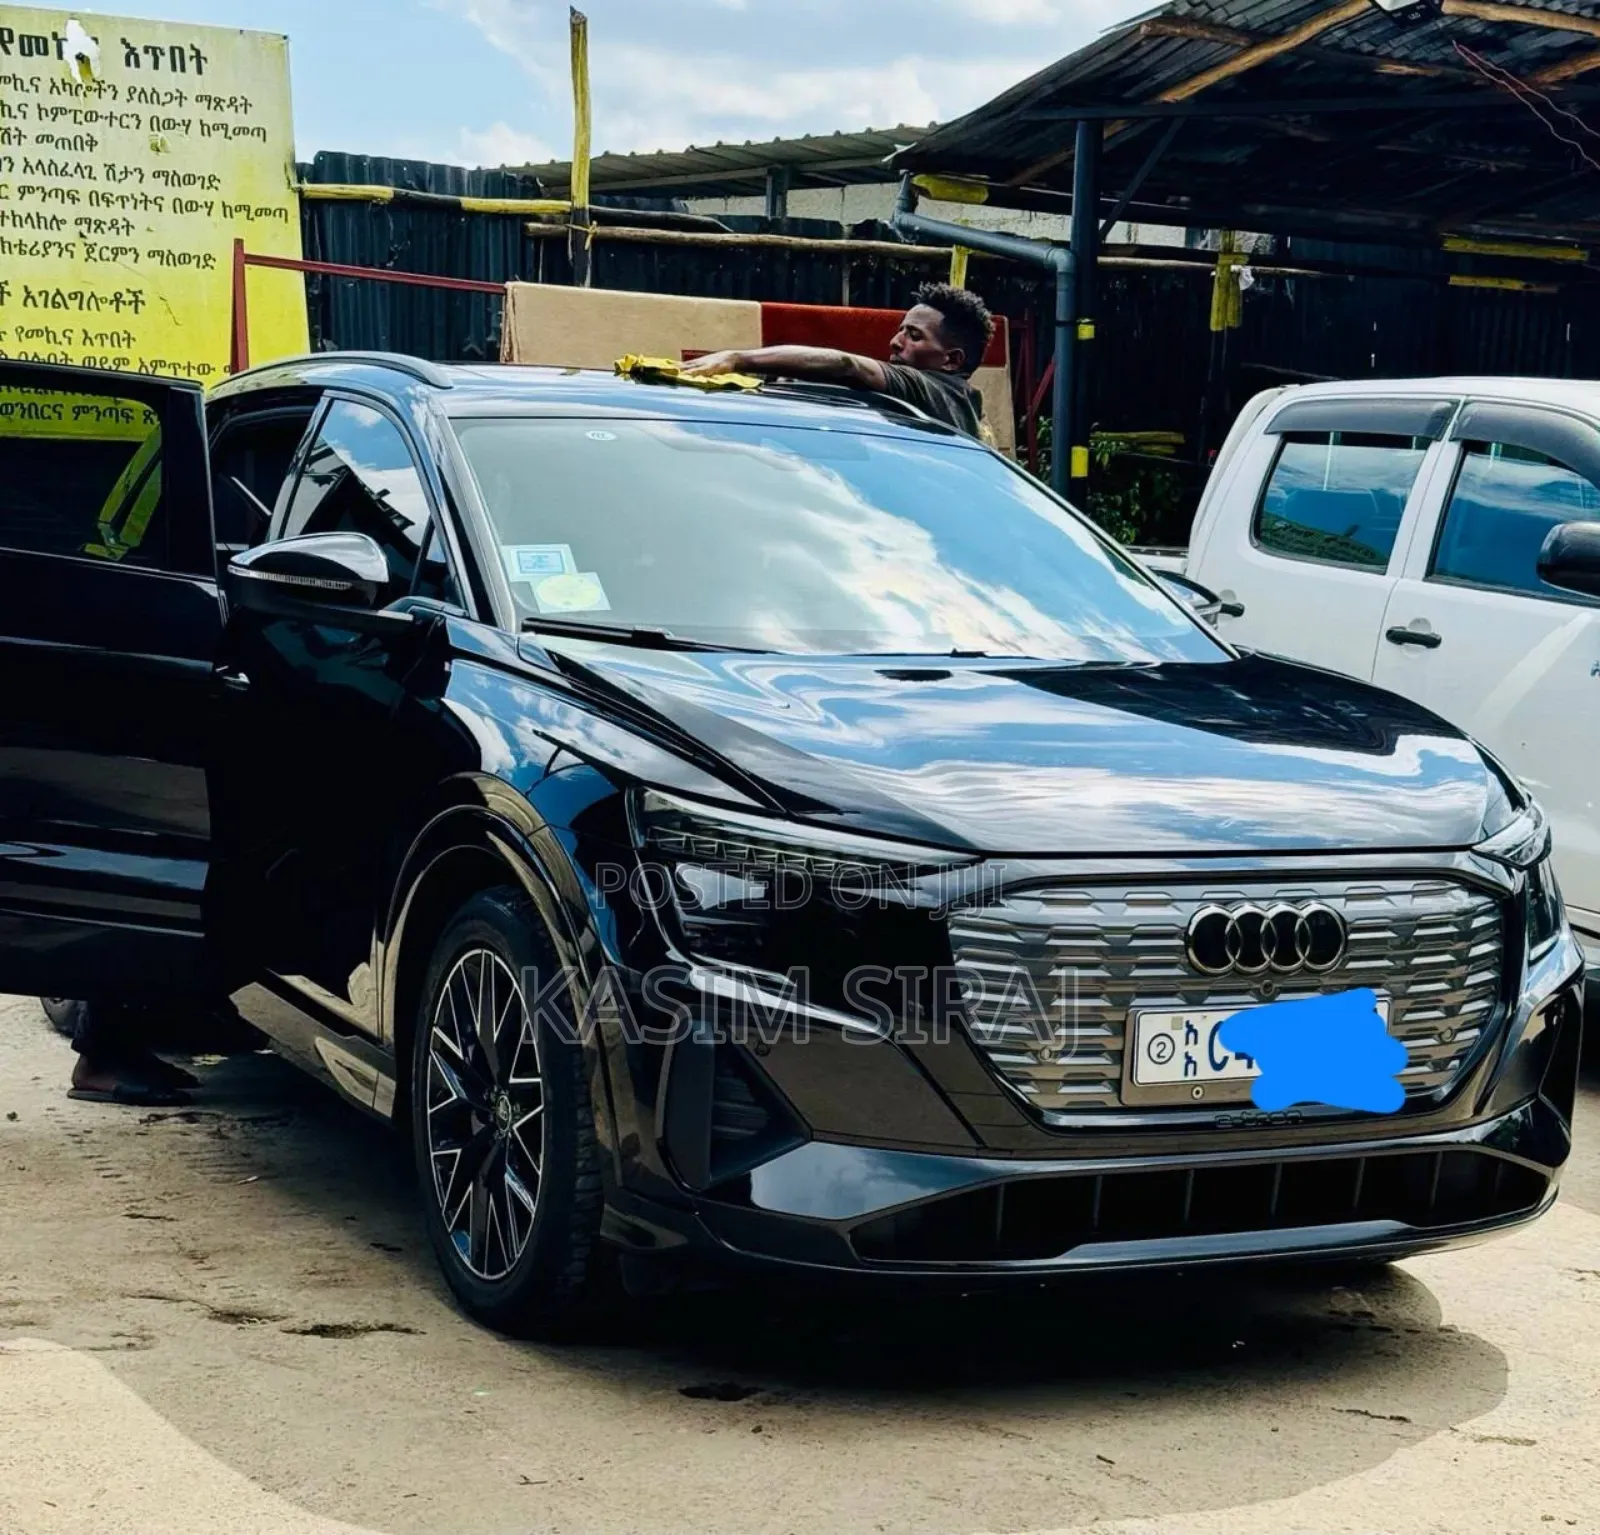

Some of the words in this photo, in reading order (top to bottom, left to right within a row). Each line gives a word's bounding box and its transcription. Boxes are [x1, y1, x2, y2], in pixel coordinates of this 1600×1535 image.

[120, 36, 208, 76] እጥበት
[125, 84, 189, 109] ያለስጋት
[194, 93, 253, 115] ማጽዳት
[36, 102, 142, 131] ኮምፒውተርን
[149, 114, 192, 136] በውሃ
[199, 118, 267, 143] ከሚመጣ
[34, 132, 99, 153] መጠበቅ
[22, 156, 97, 181] አላስፈላጊ
[103, 162, 145, 184] ሽታን
[151, 169, 221, 191] ማስወገድ
[17, 184, 81, 206] ምንጣፍ
[88, 189, 165, 213] በፍጥነትና
[172, 196, 214, 217] በውሃ
[221, 200, 289, 224] ከሚመጣ
[74, 216, 136, 237] ማጽዳት
[146, 248, 217, 271] ማስወገድ
[22, 284, 147, 315] አገልግሎቶች
[14, 325, 74, 346] የመኪና
[81, 328, 137, 350] እጥበት
[71, 404, 135, 425] ምንጣፍ
